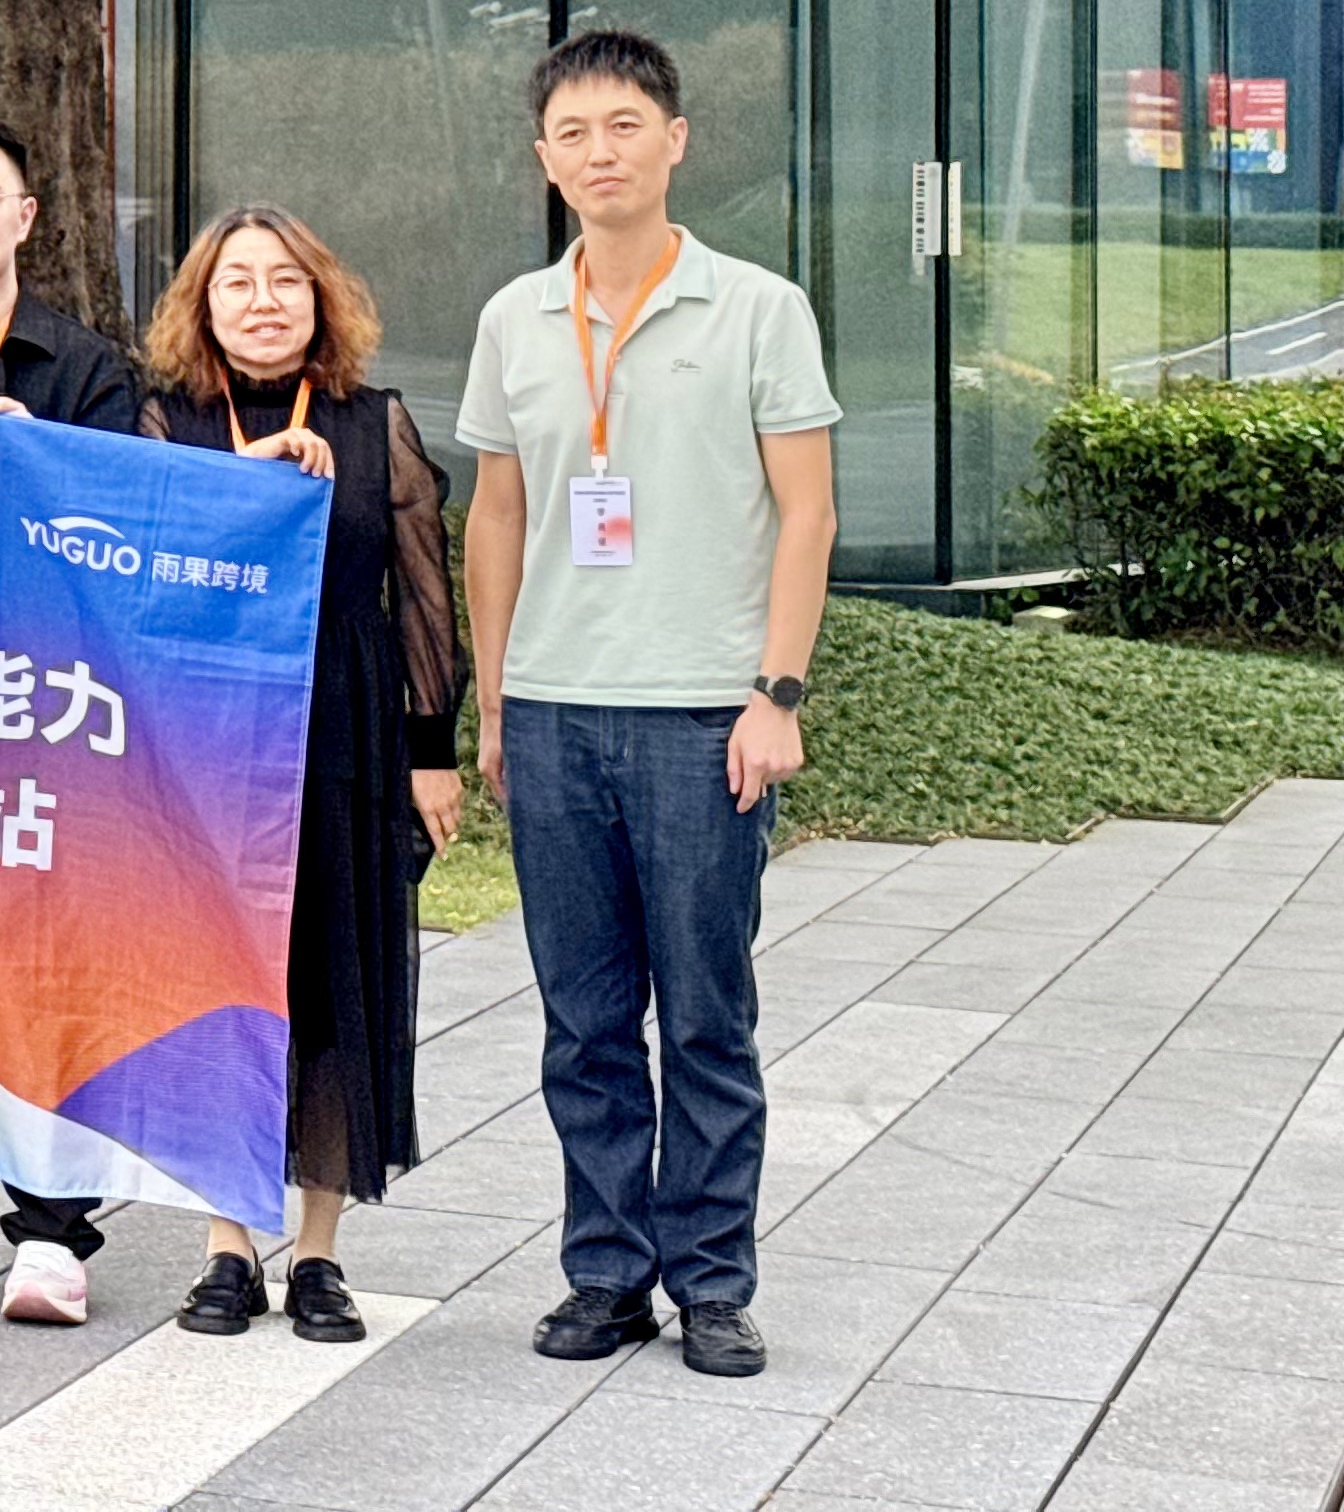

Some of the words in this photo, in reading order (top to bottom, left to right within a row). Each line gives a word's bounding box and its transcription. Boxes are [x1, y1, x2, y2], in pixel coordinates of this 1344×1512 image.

[19, 516, 141, 576] YUGUO
[151, 550, 269, 594] 雨果跨境
